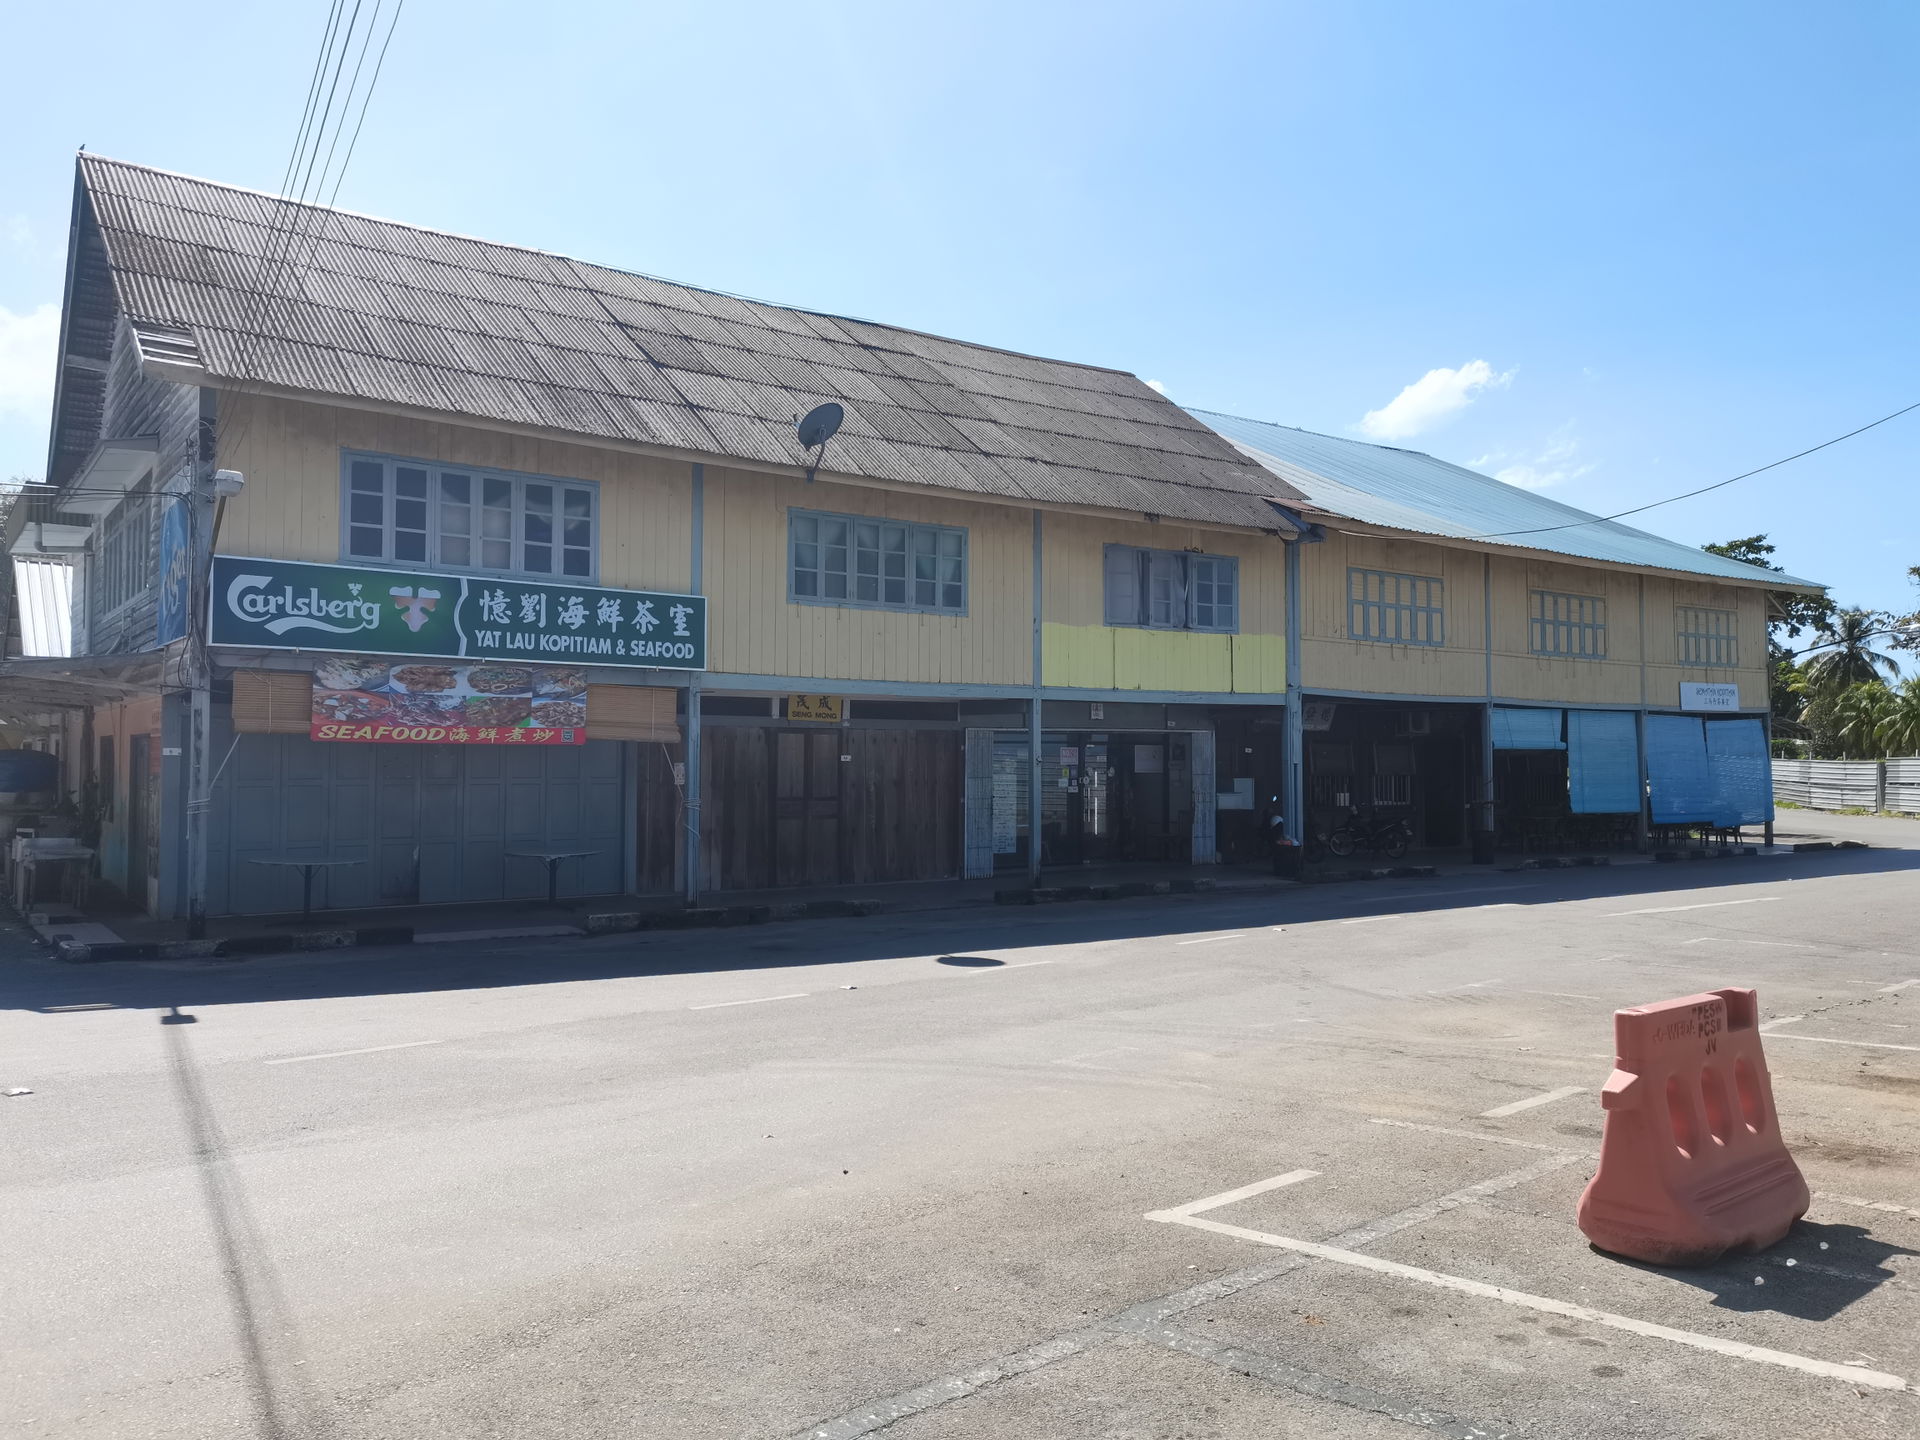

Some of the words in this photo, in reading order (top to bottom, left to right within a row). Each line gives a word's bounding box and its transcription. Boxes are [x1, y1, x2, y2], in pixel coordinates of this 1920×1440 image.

[227, 574, 381, 634] Carlsberg
[479, 589, 694, 636] 憶劉海鮮茶室
[475, 630, 500, 648] YAT
[506, 632, 535, 649] LAU
[540, 634, 612, 654] KOPITIAM
[616, 639, 626, 655] &
[630, 640, 695, 659] SEAFOOD
[318, 725, 446, 741] SEAFOOD
[449, 728, 554, 743] 海鮮煮炒
[1705, 1039, 1717, 1055] JV
